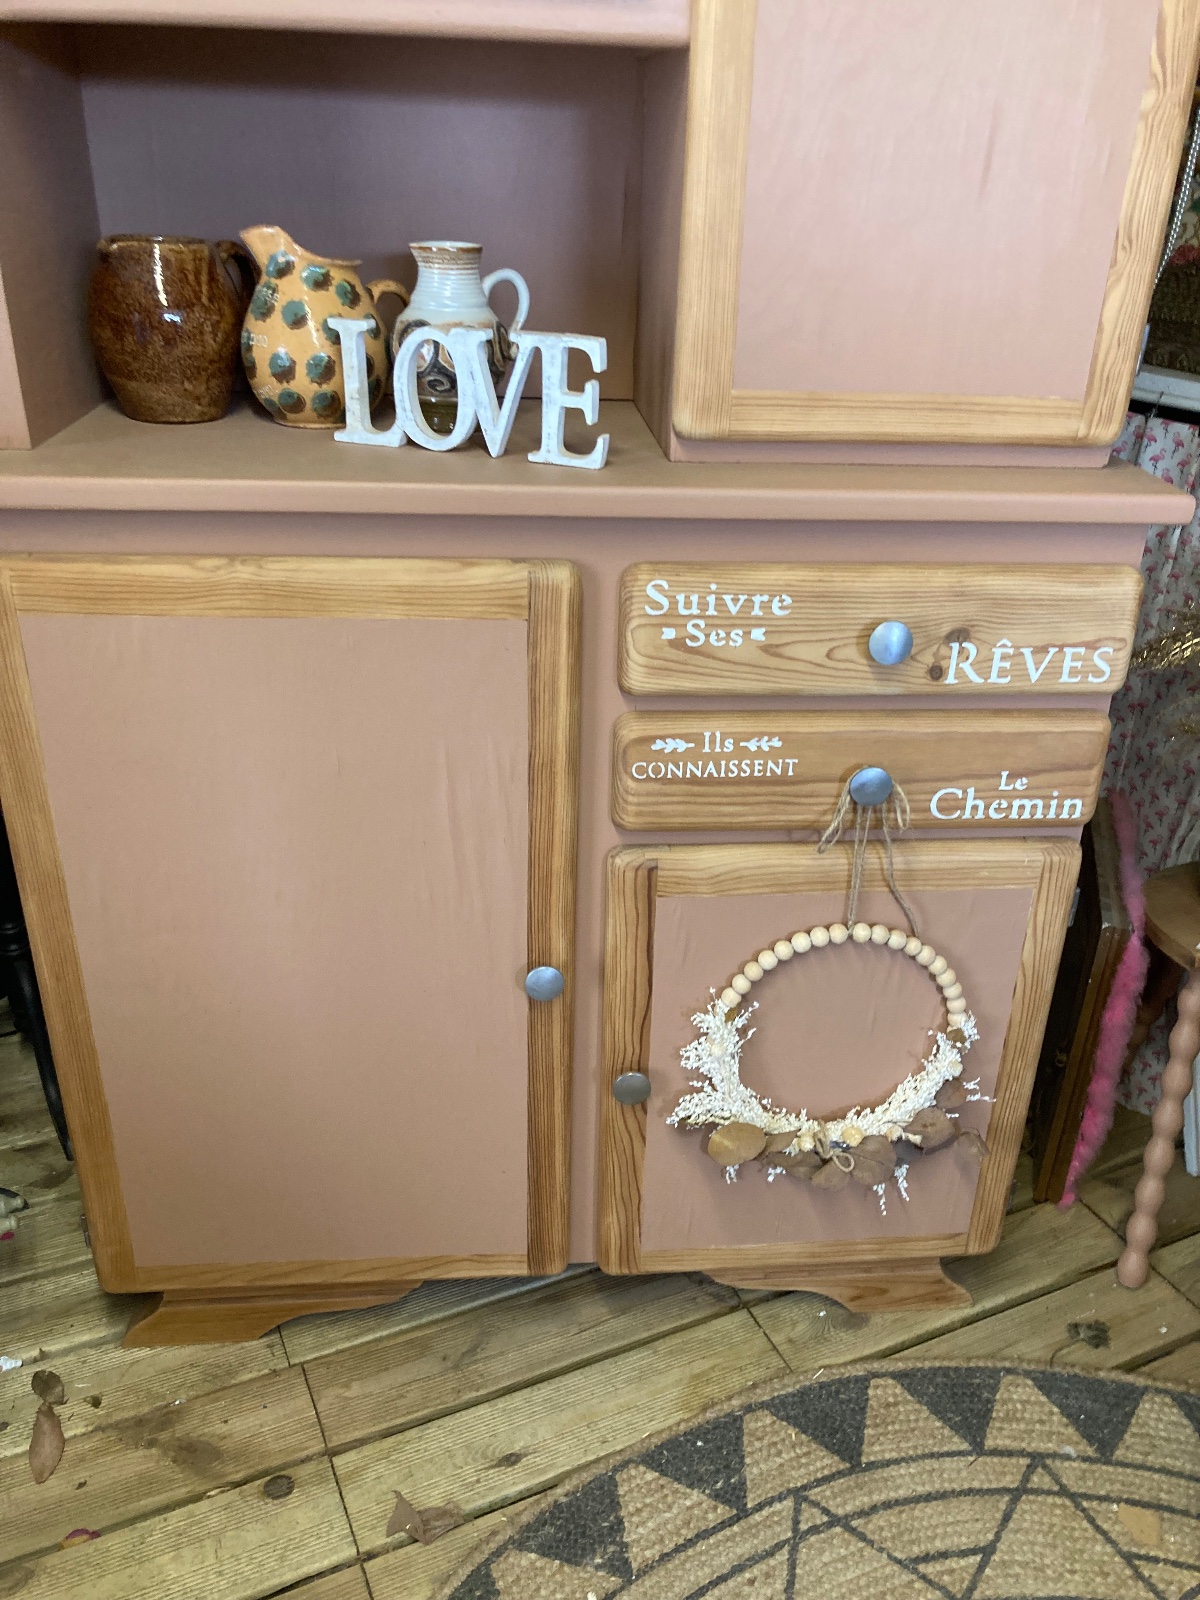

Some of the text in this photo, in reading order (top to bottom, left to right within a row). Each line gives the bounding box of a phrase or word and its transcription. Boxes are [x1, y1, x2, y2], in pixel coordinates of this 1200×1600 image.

[326, 317, 609, 470] LOVE
[644, 579, 793, 617] Suivre
[685, 619, 744, 648] Ses
[943, 639, 1114, 685] RÊVES
[702, 730, 734, 753] Ils
[631, 758, 799, 780] CONNAISSENT
[999, 770, 1029, 792] Le
[930, 787, 1084, 820] Chemin
